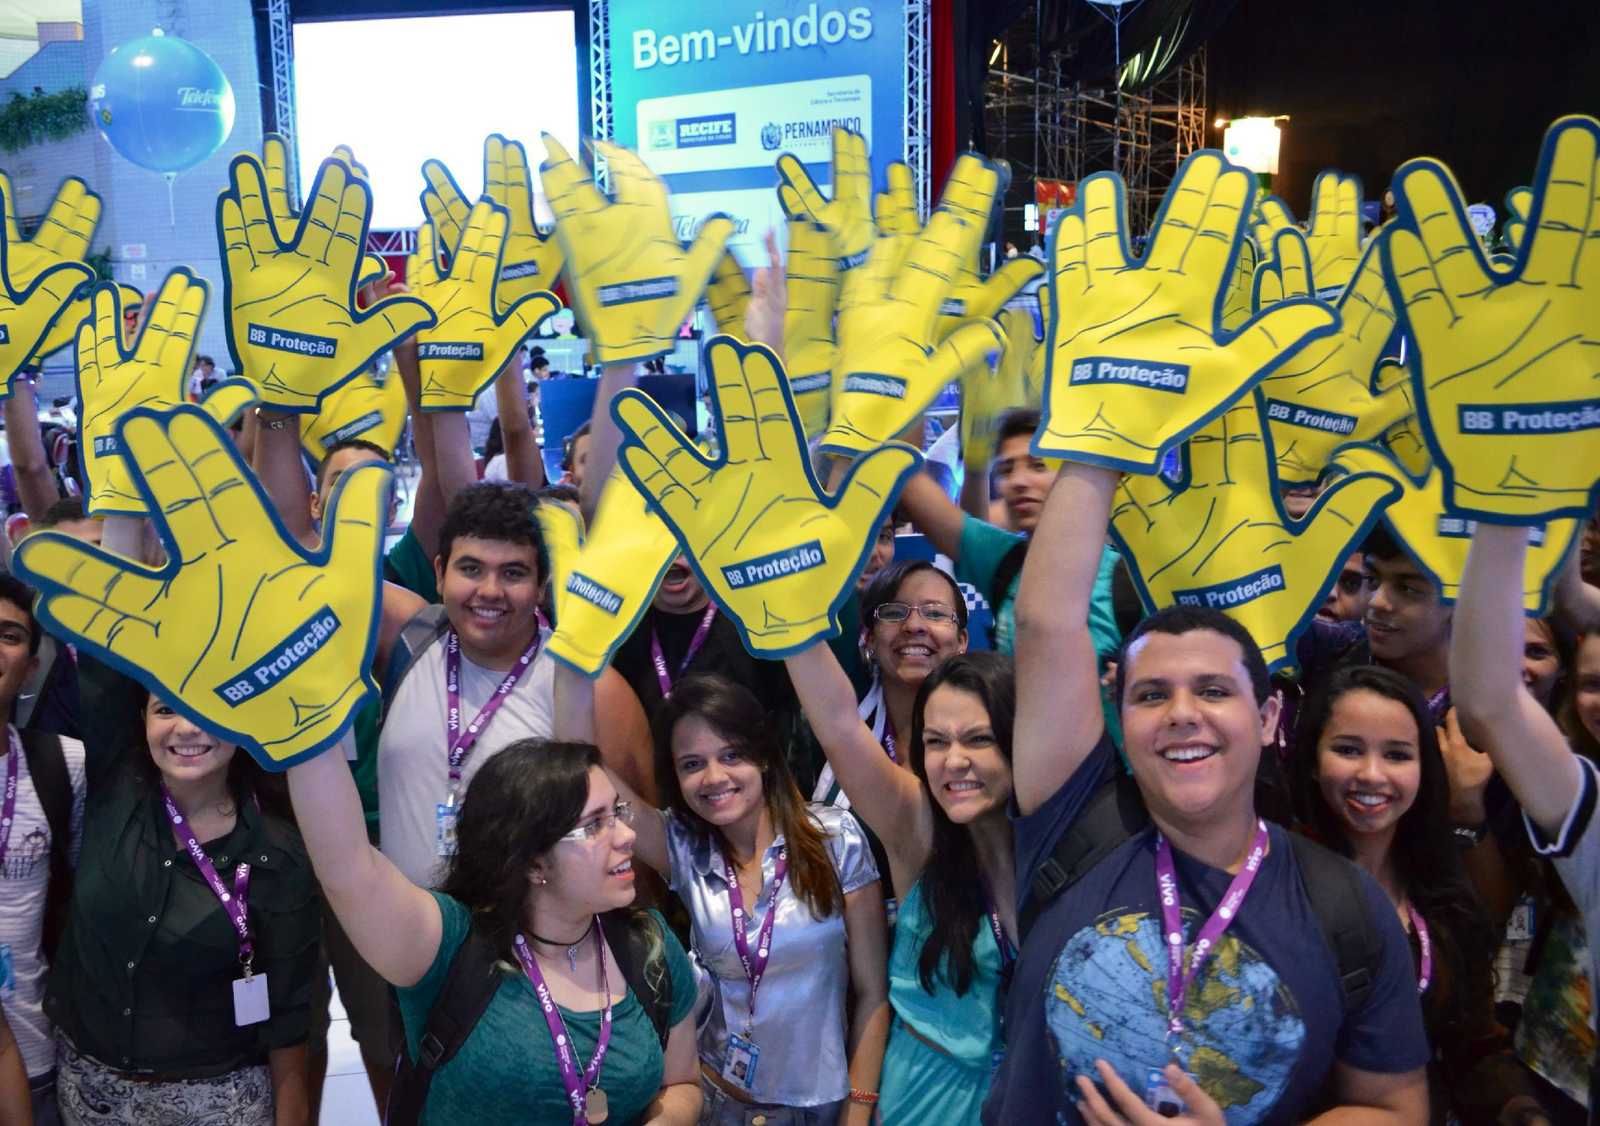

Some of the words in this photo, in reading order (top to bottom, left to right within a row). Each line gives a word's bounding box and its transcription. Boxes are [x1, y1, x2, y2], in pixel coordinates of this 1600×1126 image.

[633, 4, 872, 69] Bem-vindos
[680, 120, 732, 137] RECIFE
[250, 328, 266, 344] BB
[271, 332, 334, 355] Proteção
[429, 344, 481, 358] Proteção
[1072, 362, 1094, 381] BB
[1097, 362, 1187, 388] Proteção
[1267, 403, 1291, 419] BB
[1293, 409, 1355, 434] Proteção
[1463, 411, 1496, 429] BB
[725, 569, 745, 586] BB
[746, 548, 822, 582] Proteção
[1205, 573, 1282, 607] Proteção
[448, 633, 459, 654] vivo
[223, 679, 255, 702] BB
[253, 615, 336, 685] Proteção
[654, 654, 667, 677] vivo
[499, 675, 517, 694] vivo
[448, 707, 459, 731] vivo
[451, 747, 464, 766] vivo
[885, 734, 896, 758] vivo
[6, 775, 17, 799] vivo
[188, 838, 205, 861] vivo
[1247, 846, 1263, 872] vivo
[238, 862, 248, 879] viv
[1160, 873, 1177, 907] vivo
[237, 915, 249, 938] vivo
[1191, 938, 1211, 969] vivo
[536, 982, 553, 1013] vivo
[587, 1044, 606, 1073] vivo
[570, 1089, 586, 1112] viv
